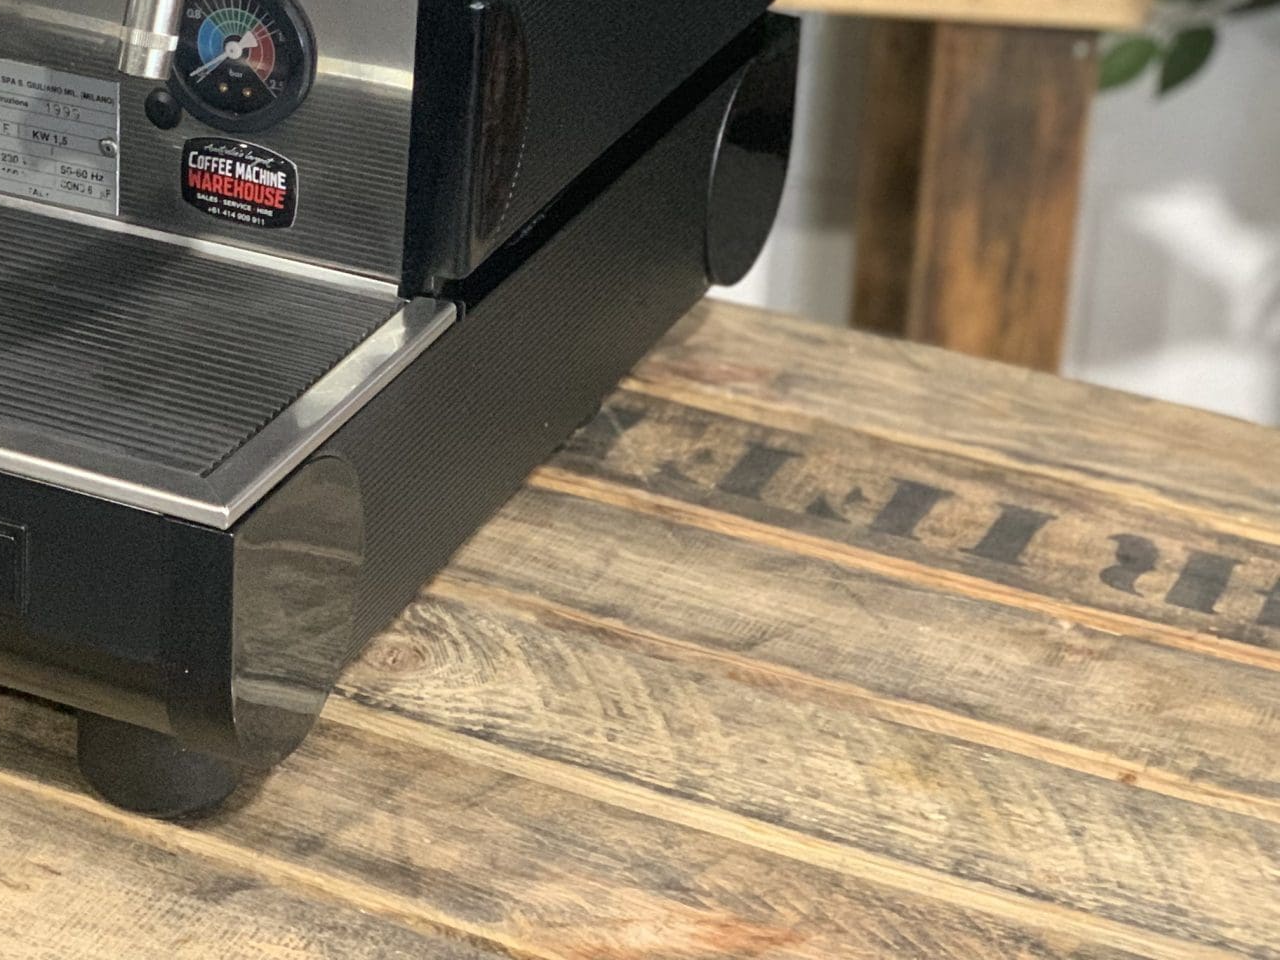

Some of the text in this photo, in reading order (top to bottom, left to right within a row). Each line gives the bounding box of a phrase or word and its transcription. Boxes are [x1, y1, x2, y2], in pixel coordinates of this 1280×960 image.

[32, 130, 50, 141] KW
[188, 151, 287, 190] COFFEE MACHINE
[188, 167, 287, 209] WAREHOUSE
[196, 192, 218, 203] SALES
[223, 199, 252, 211] SERVICE
[222, 208, 236, 218] 414
